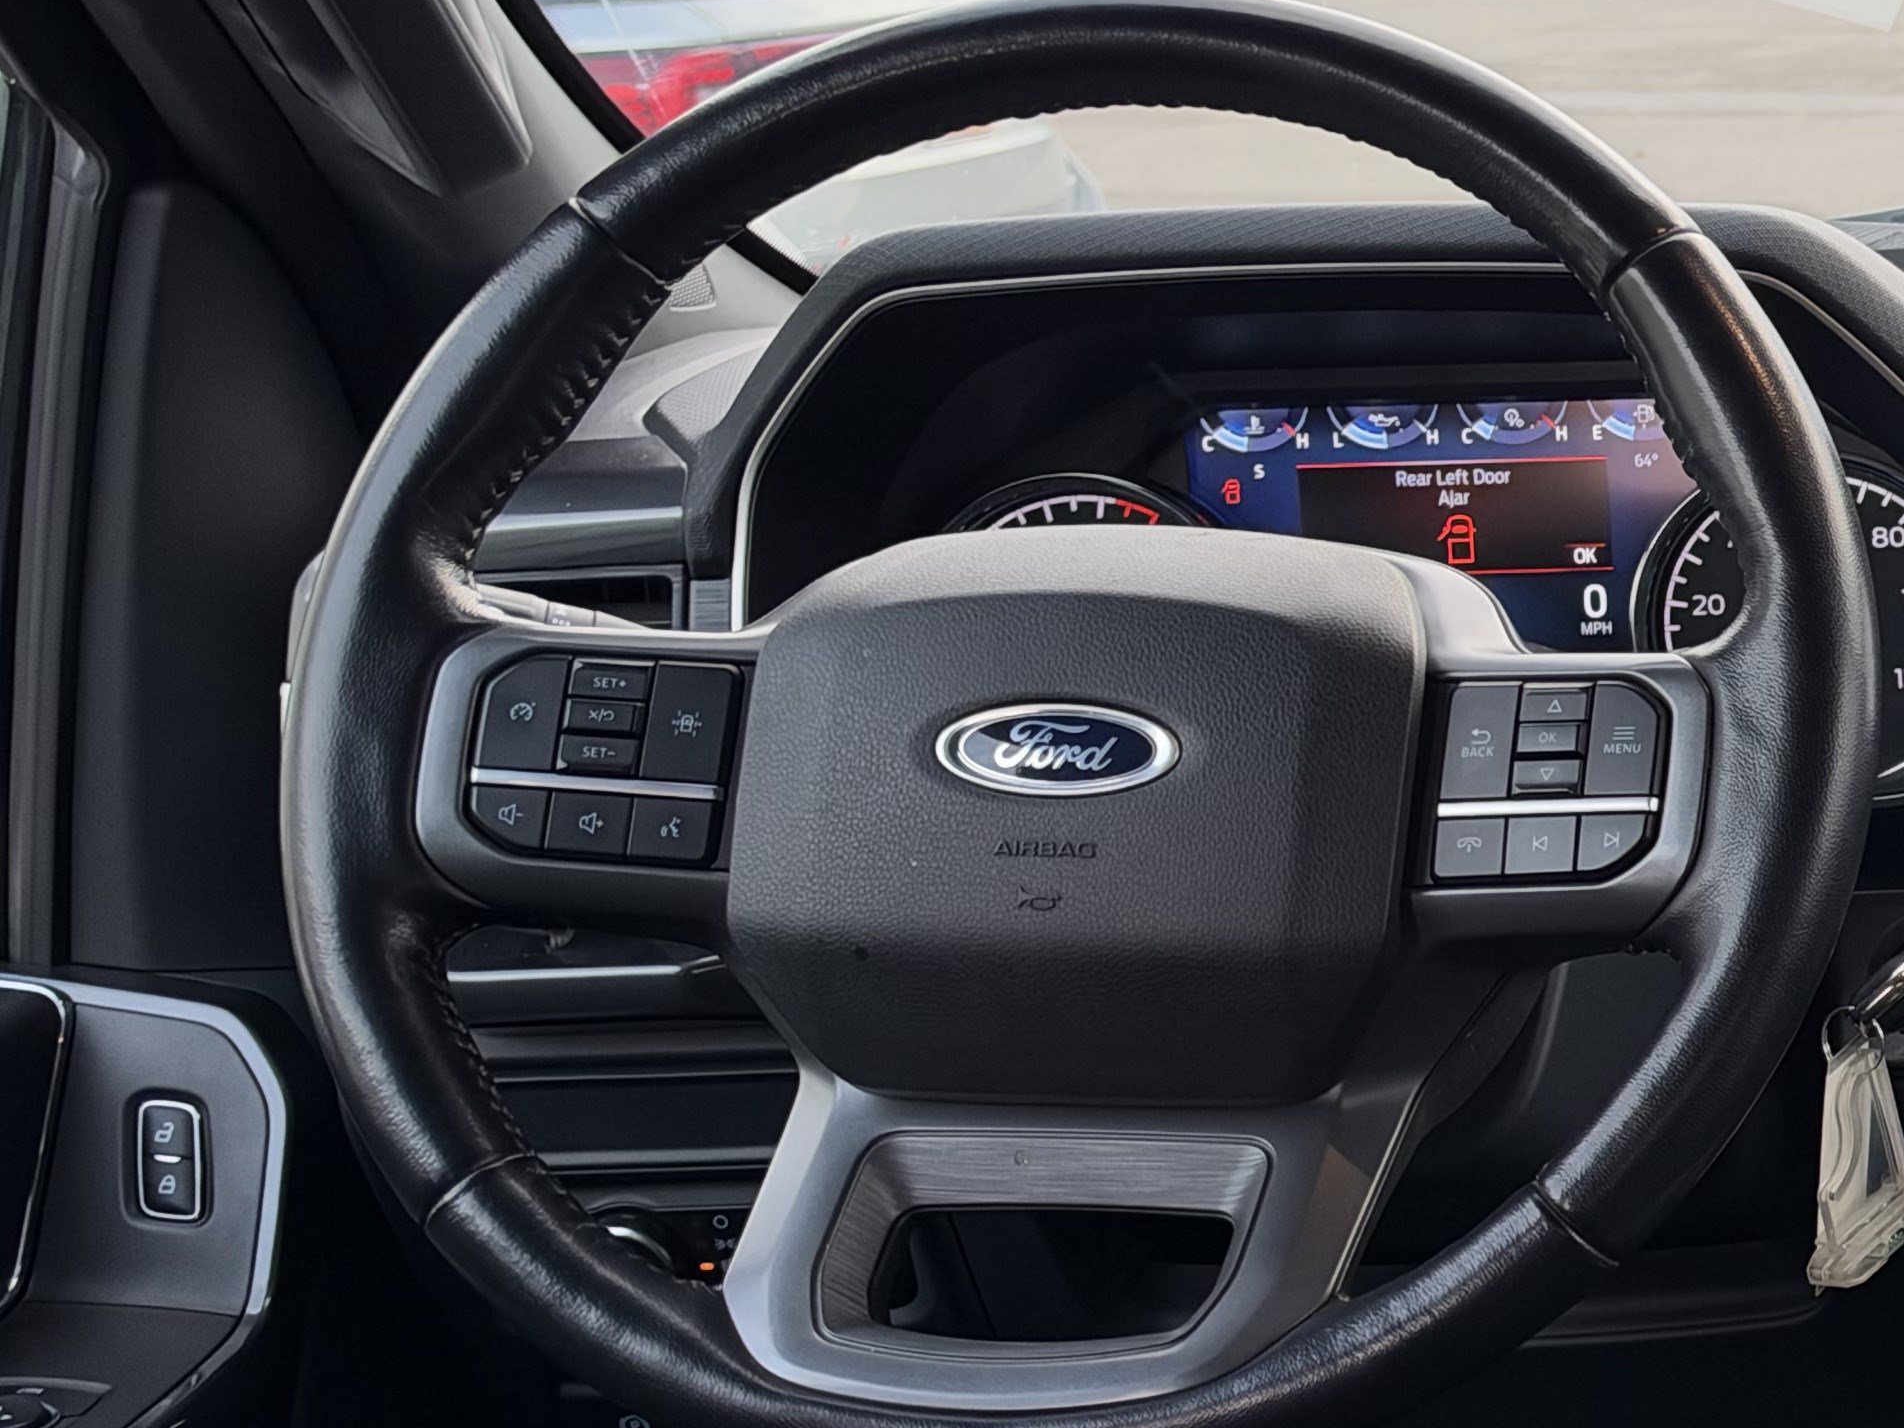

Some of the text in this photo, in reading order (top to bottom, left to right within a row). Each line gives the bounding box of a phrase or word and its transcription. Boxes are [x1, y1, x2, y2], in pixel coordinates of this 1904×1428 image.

[1296, 431, 1311, 450] H
[1332, 431, 1344, 449] L
[1426, 429, 1440, 446] H
[1461, 427, 1474, 444] C
[1555, 424, 1568, 442] H
[1593, 423, 1603, 441] E
[1201, 434, 1215, 453] C
[1634, 452, 1659, 469] 64°
[1253, 463, 1265, 480] S
[1395, 466, 1511, 488] Rear Left Door
[1438, 489, 1471, 508] Ajar
[1572, 546, 1597, 565] OK
[1583, 582, 1608, 621] 0
[1692, 593, 1726, 617] 20
[1580, 621, 1613, 637] MPH
[592, 676, 627, 689] SET+
[993, 719, 1119, 772] Ford
[1539, 732, 1556, 743] OK
[1461, 746, 1494, 758] BACK
[1603, 743, 1641, 754] MENU
[994, 840, 1097, 858] AIRBAG
